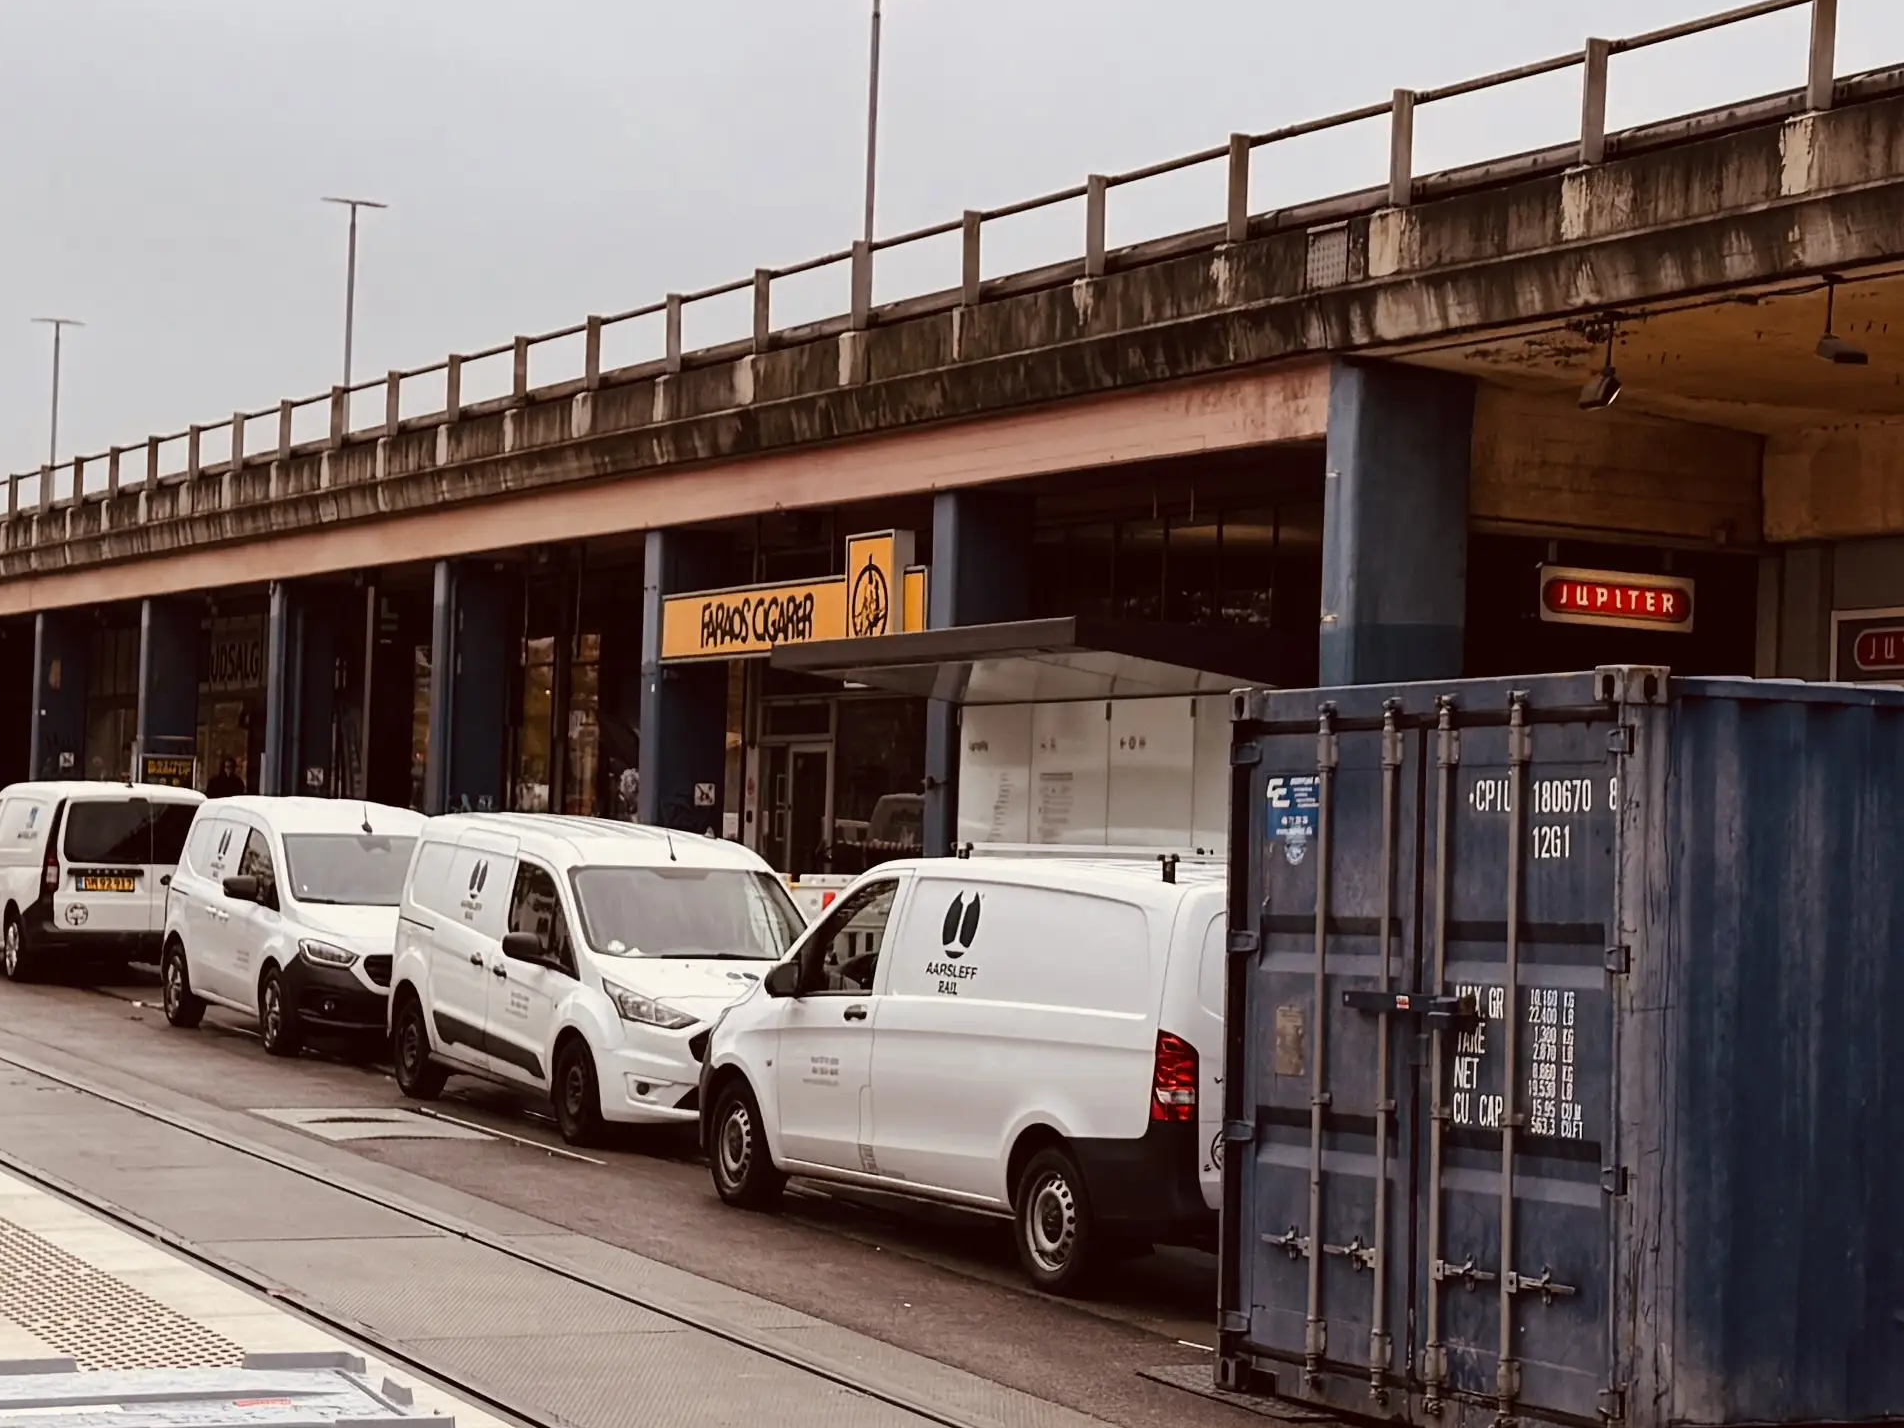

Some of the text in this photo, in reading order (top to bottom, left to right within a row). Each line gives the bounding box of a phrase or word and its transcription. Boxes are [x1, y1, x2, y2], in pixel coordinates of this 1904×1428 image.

[1560, 584, 1676, 614] JUPITER
[701, 592, 814, 648] FARAOS CIGARER
[211, 641, 259, 682] UDSALG
[1533, 779, 1592, 813] 180670
[1609, 777, 1618, 811] 8
[1532, 824, 1570, 859] 12G1
[926, 961, 978, 980] AARSLEFF
[1489, 987, 1504, 1019] GR
[1453, 1056, 1480, 1089] NET
[1453, 1092, 1503, 1128] CU. CAP
